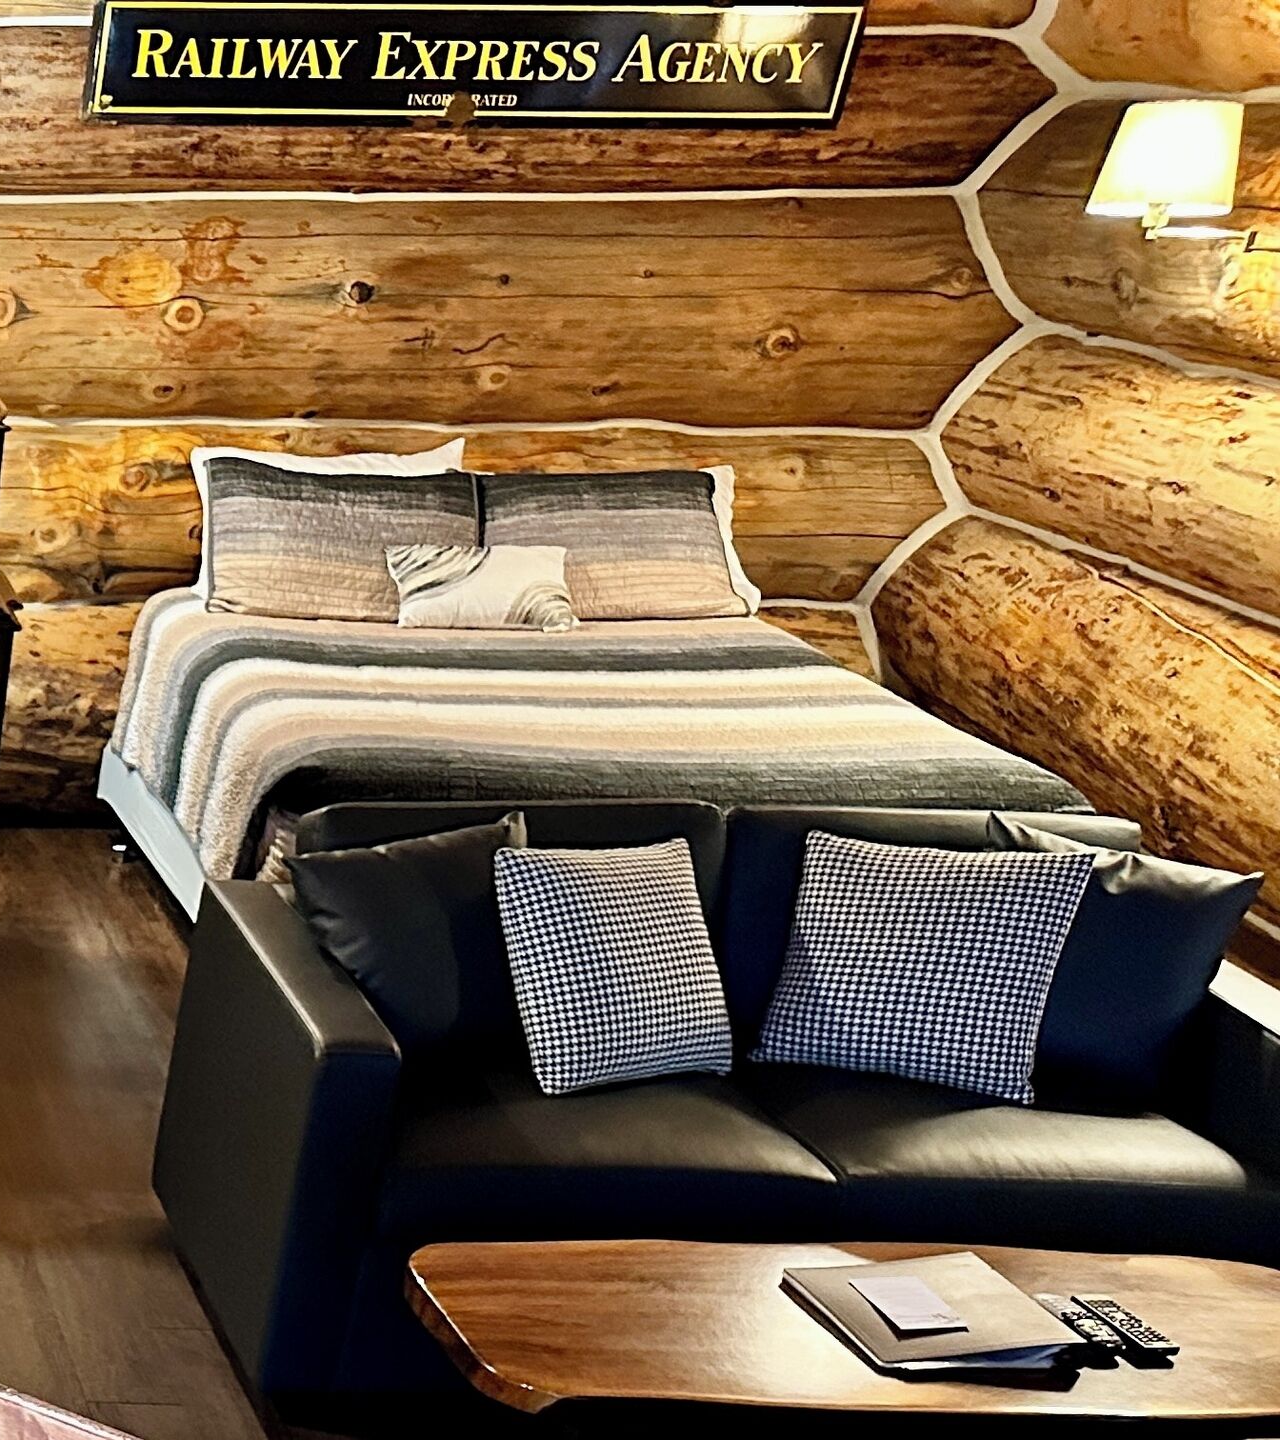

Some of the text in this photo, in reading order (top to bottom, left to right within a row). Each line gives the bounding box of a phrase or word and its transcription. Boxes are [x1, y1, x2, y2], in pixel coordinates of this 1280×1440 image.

[132, 28, 824, 83] RAILWAY EXPRESS AGENCY
[407, 93, 518, 107] INCORRATED
